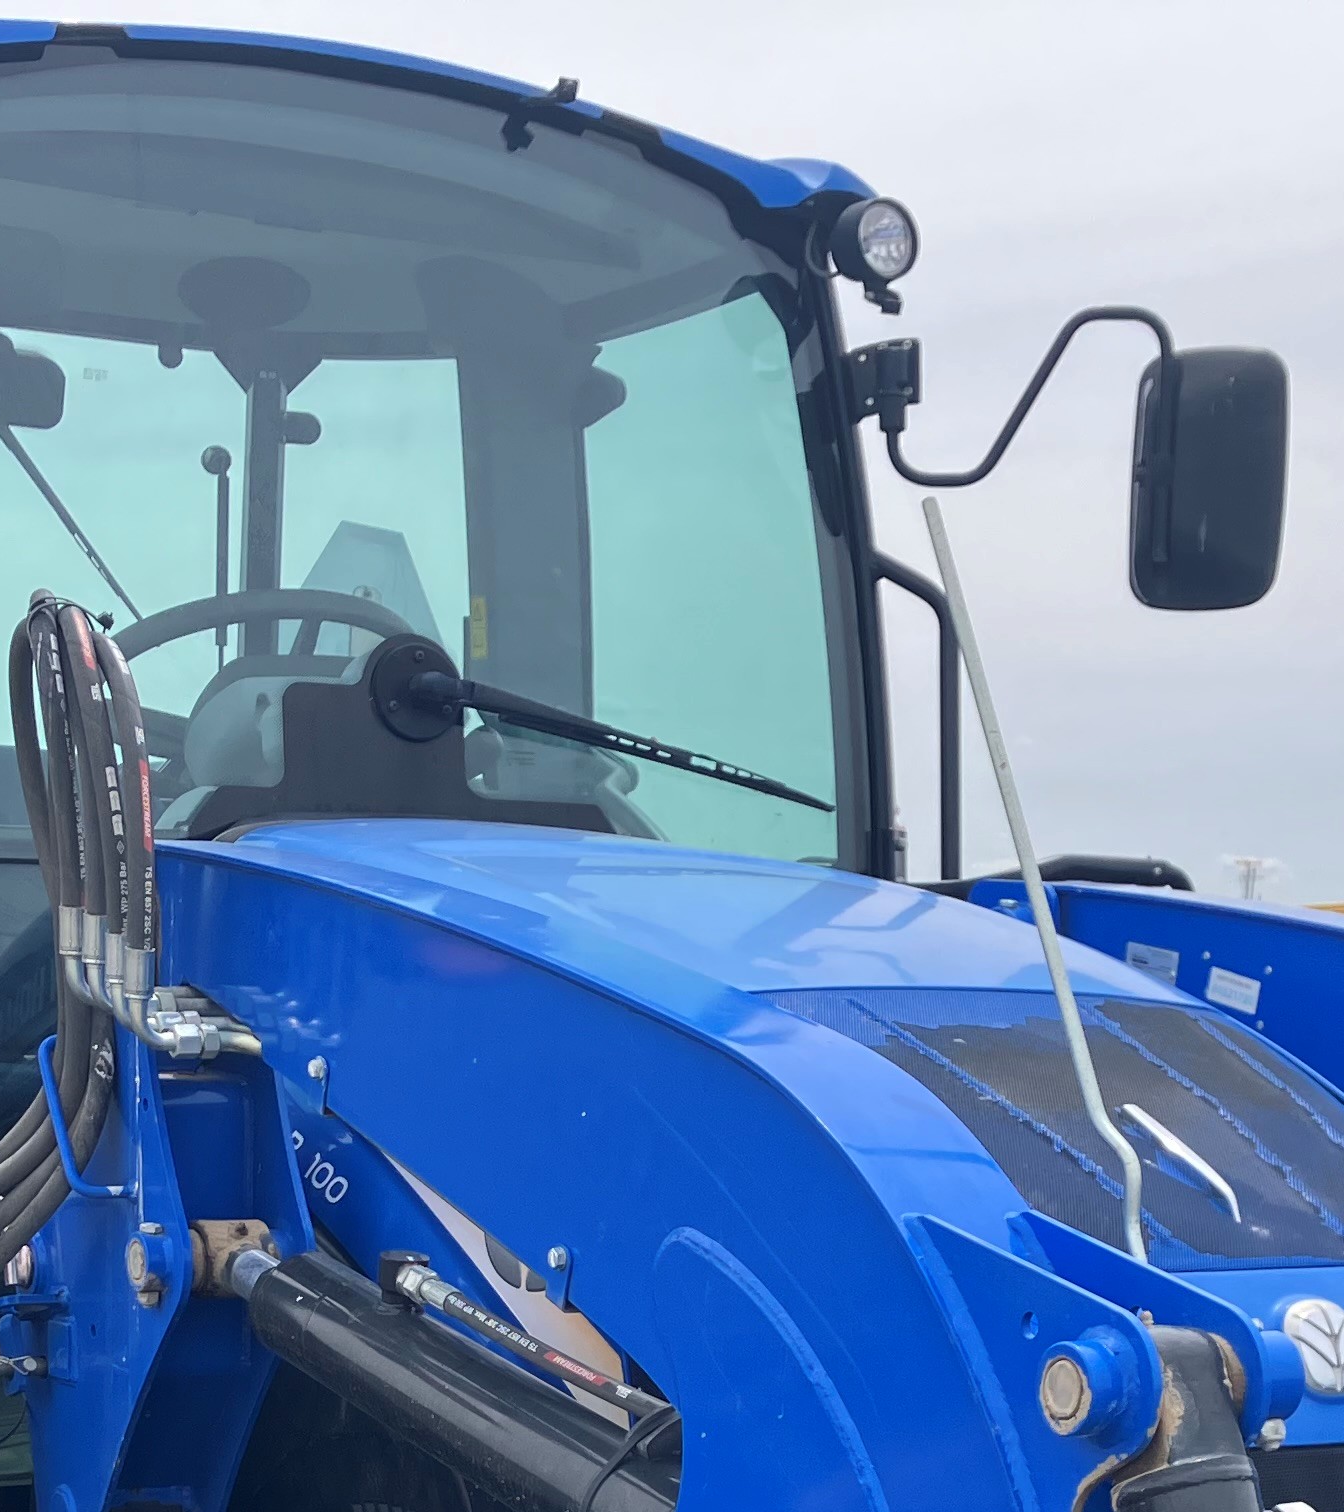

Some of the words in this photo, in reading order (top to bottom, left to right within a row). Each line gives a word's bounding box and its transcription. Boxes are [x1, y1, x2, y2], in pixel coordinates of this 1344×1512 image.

[140, 774, 153, 839] FORCESTREAM
[143, 915, 152, 935] 2SC
[304, 1152, 349, 1204] 100
